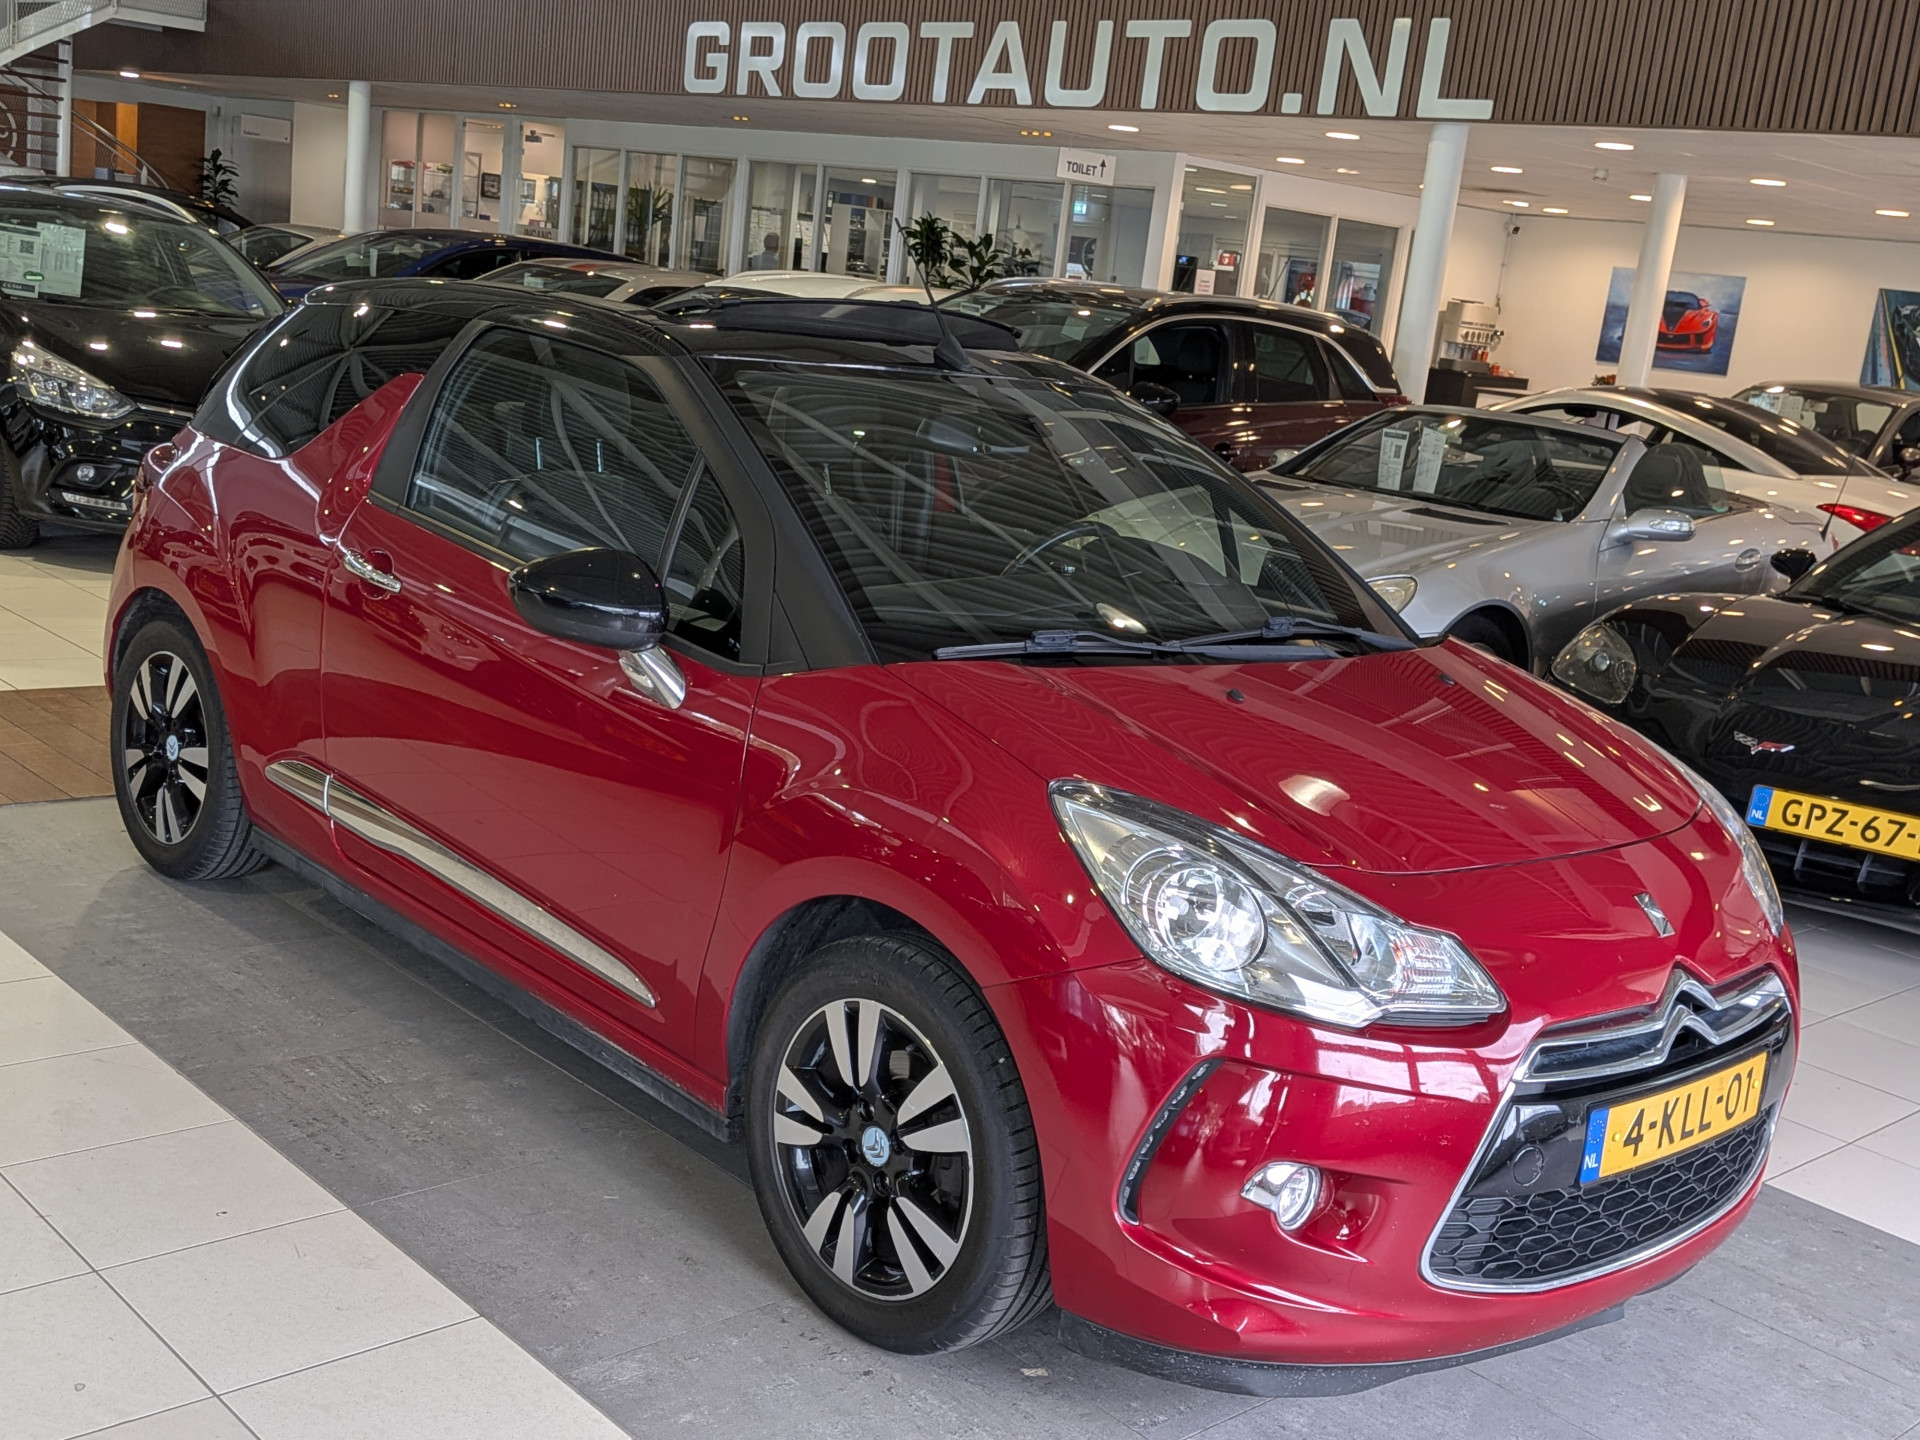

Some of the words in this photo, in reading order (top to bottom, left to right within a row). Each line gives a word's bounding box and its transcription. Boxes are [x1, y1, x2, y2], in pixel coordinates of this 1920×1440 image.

[684, 17, 1495, 120] GROOTAUTO.NL
[1066, 161, 1097, 177] TOILET
[1751, 808, 1765, 821] NL
[1781, 799, 1920, 854] GPZ-67-
[1623, 1066, 1754, 1157] 4-KLL-01
[1583, 1153, 1599, 1171] NL
